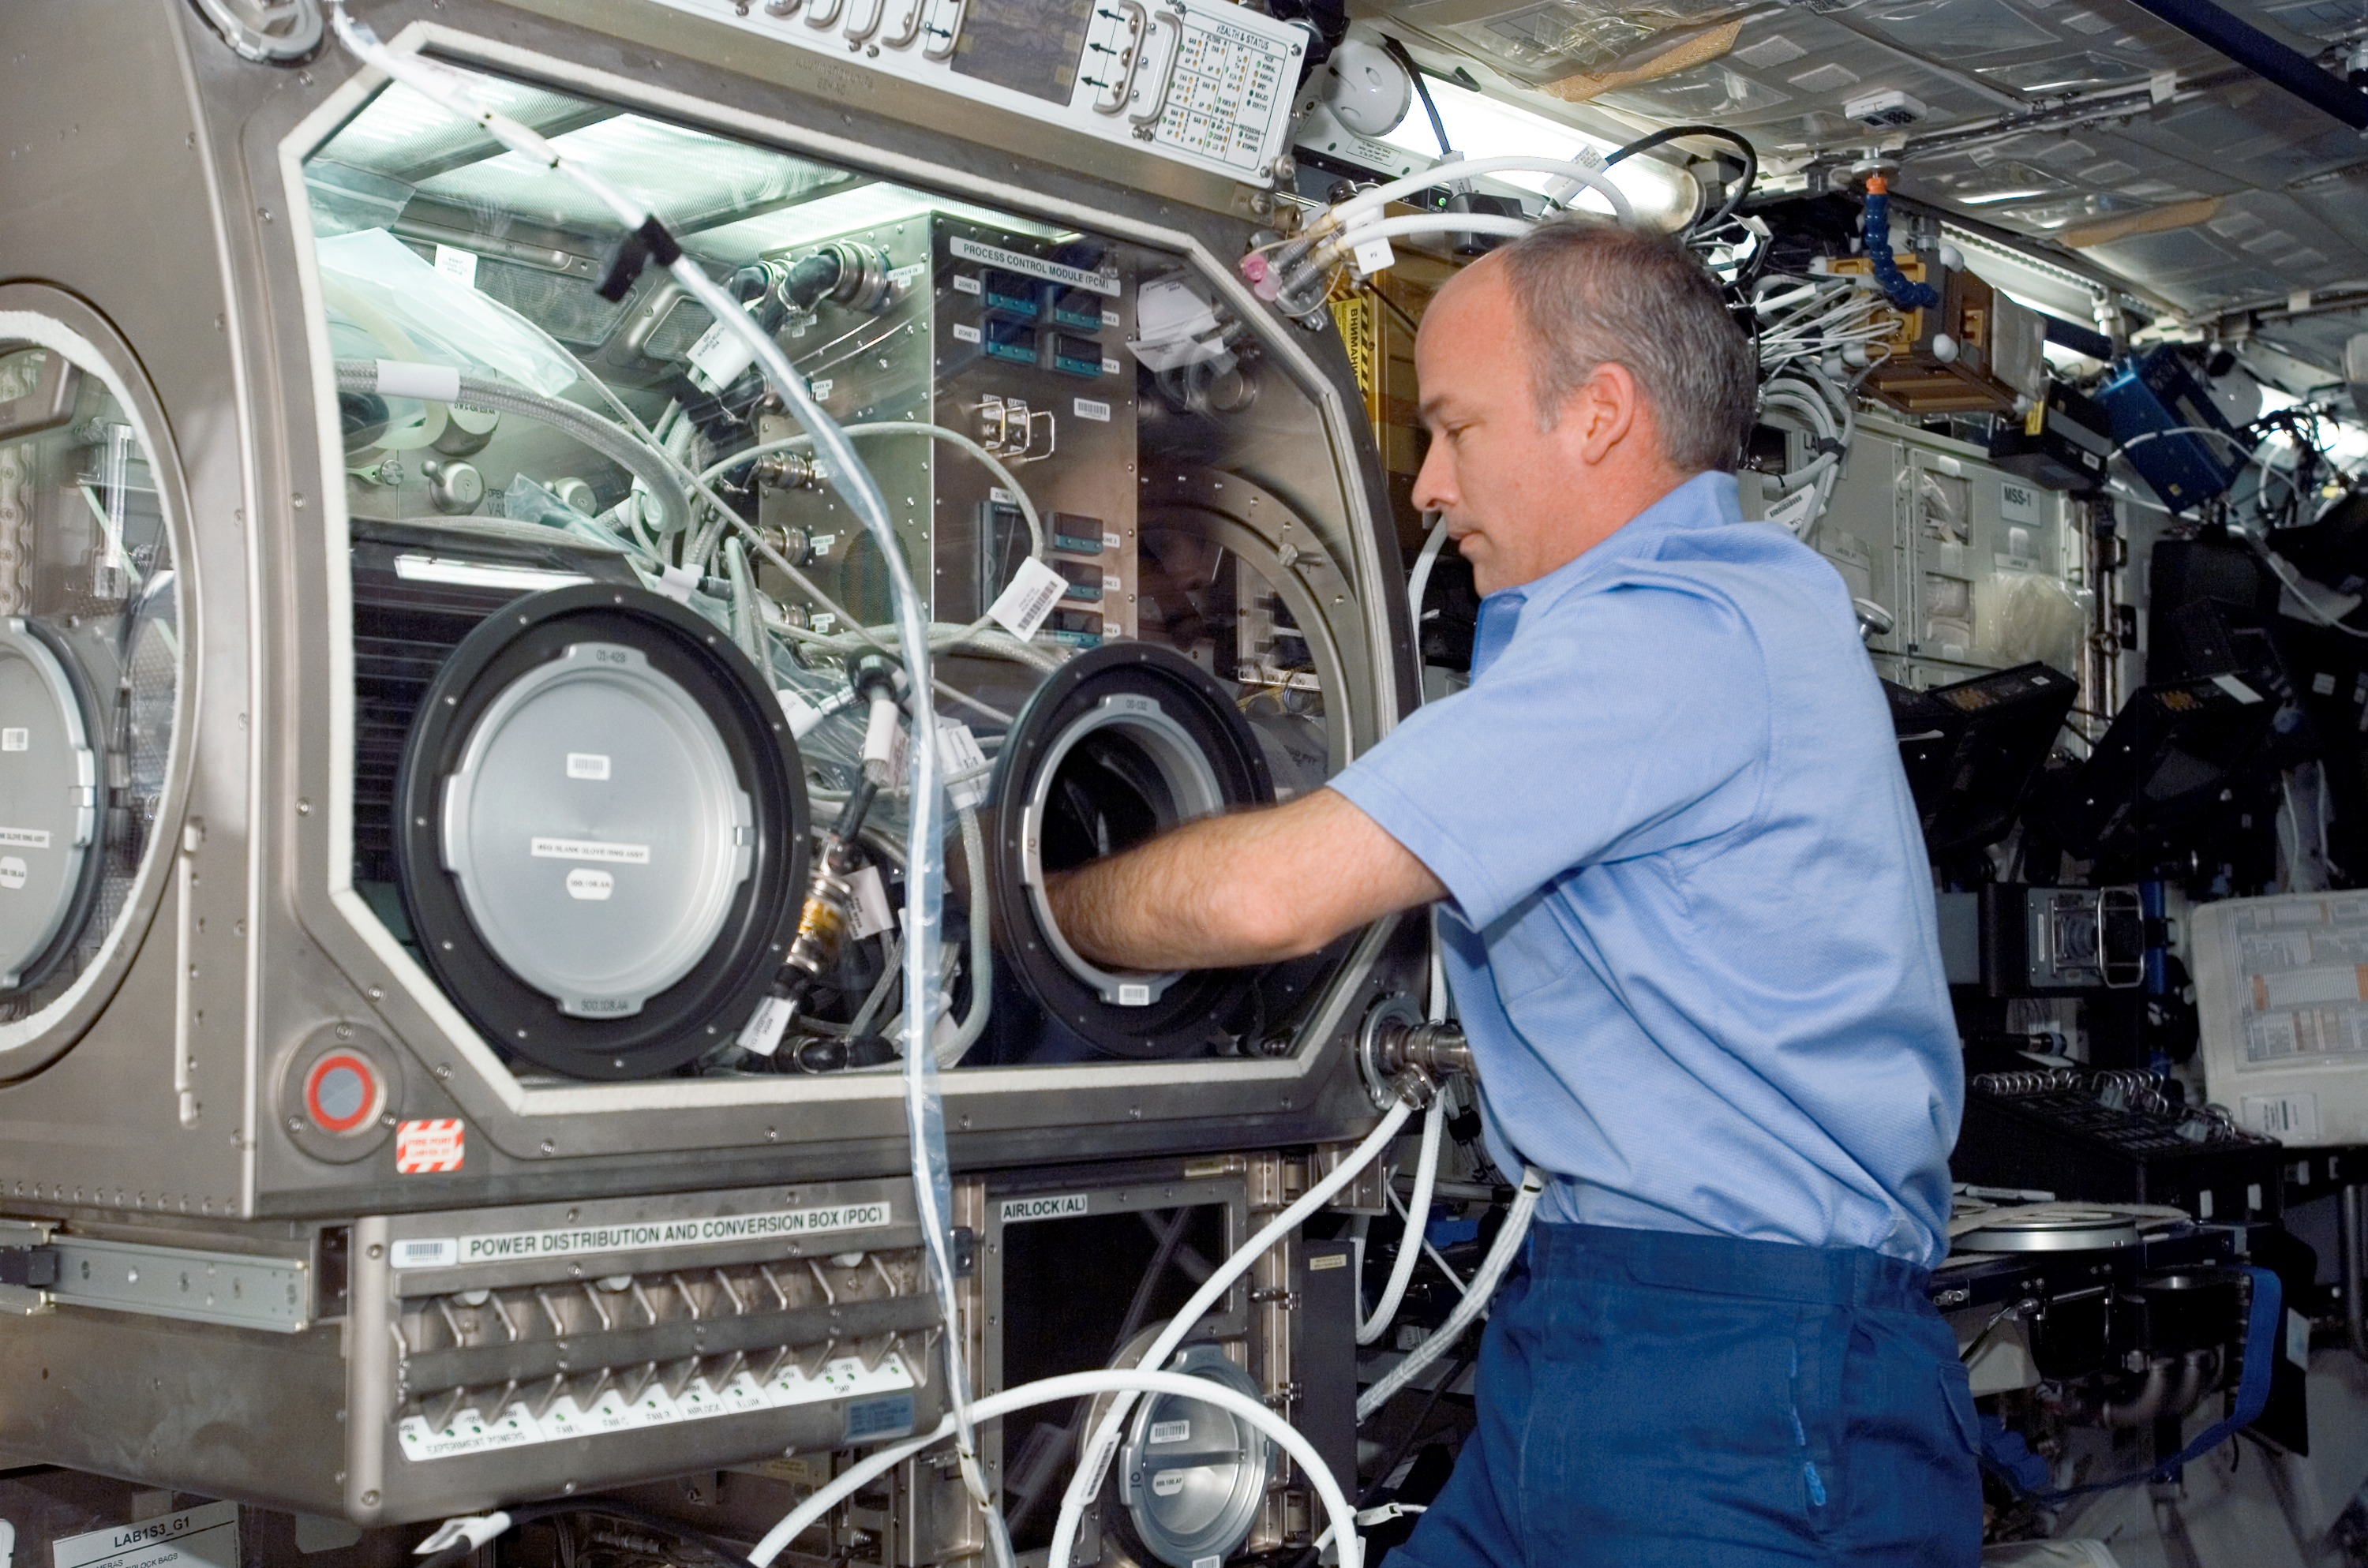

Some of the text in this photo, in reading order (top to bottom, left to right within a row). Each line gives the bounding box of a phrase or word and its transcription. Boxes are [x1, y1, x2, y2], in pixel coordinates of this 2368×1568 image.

[1216, 24, 1239, 40] HEALTH
[1246, 34, 1269, 50] STATUS
[964, 243, 1109, 290] PROCESS CONTROL MODULE (PCM)
[958, 279, 972, 290] ZONE
[958, 328, 972, 338] ZONE
[2004, 486, 2031, 507] MSS-1
[554, 845, 579, 854] BLANK
[470, 1207, 882, 1257] POWER DISTRIBUTION AND CONVERSION BOX (PDC)
[426, 1431, 526, 1456] EXPERIMENT POWERS
[114, 1516, 189, 1548] LAB1S3_G1
[158, 1553, 179, 1564] BAGS
